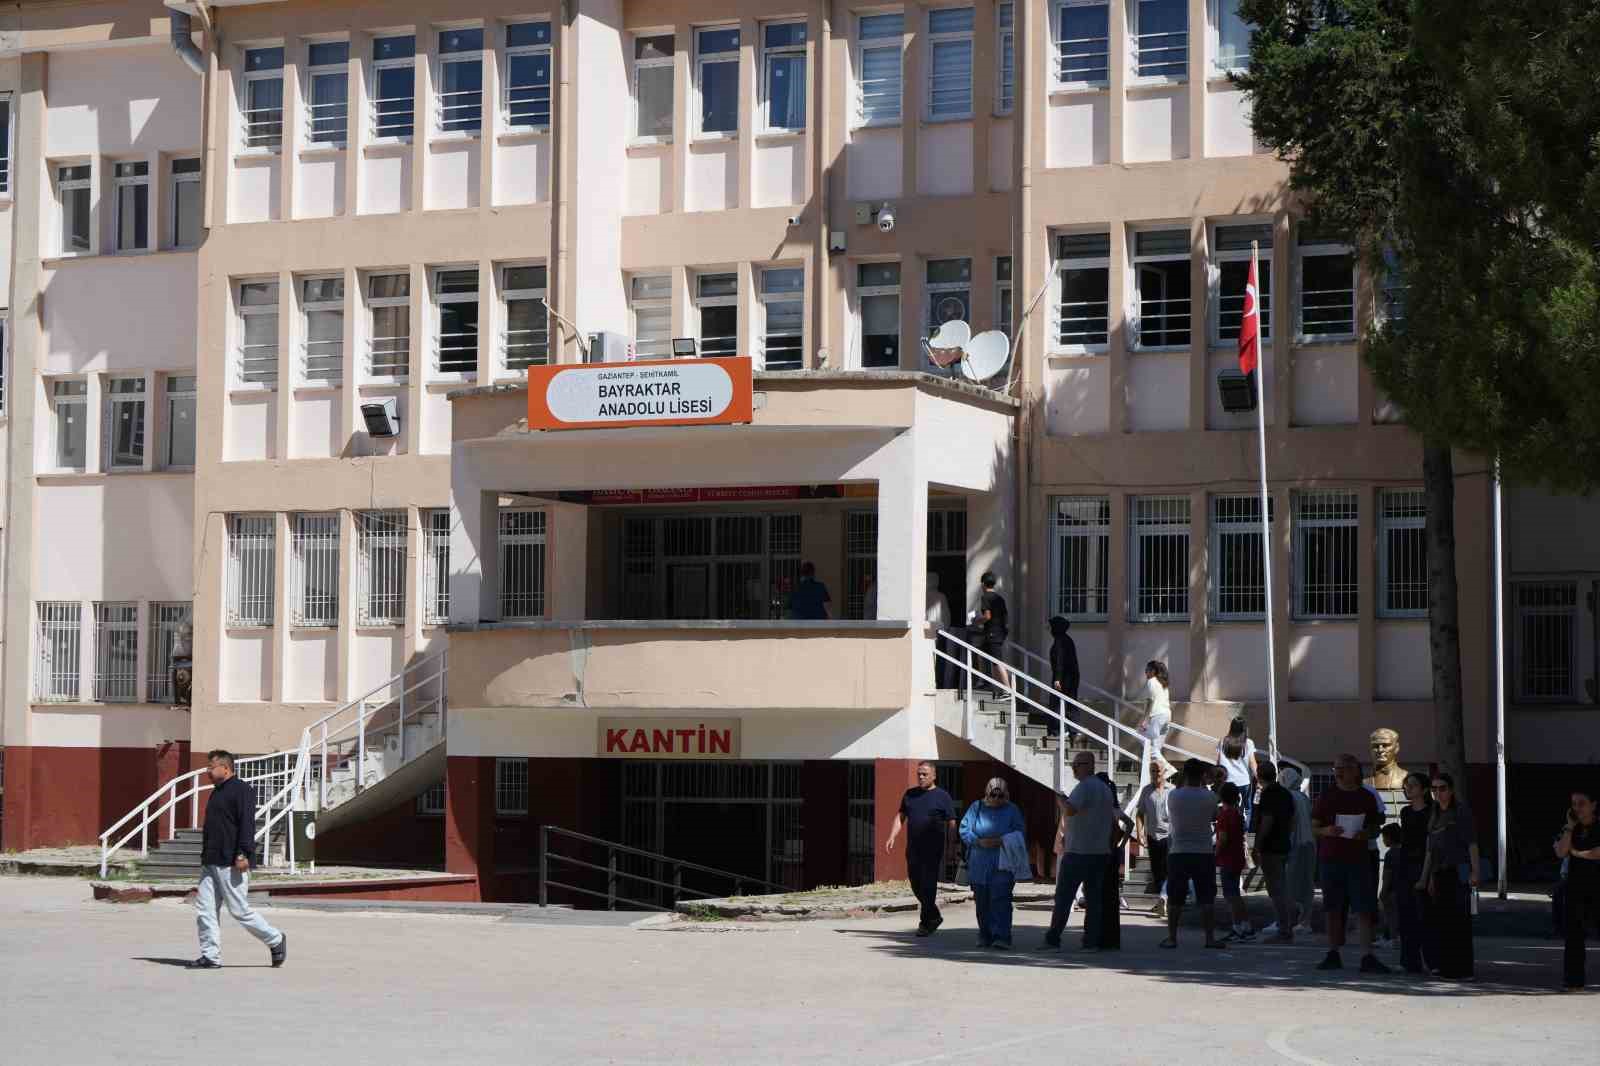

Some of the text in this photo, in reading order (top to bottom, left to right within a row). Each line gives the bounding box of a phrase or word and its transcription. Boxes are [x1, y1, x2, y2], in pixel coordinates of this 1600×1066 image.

[599, 382, 681, 398] BAYRAKTAR
[598, 396, 712, 416] ANADOLU LİSESİ
[606, 723, 731, 753] KANTİN
